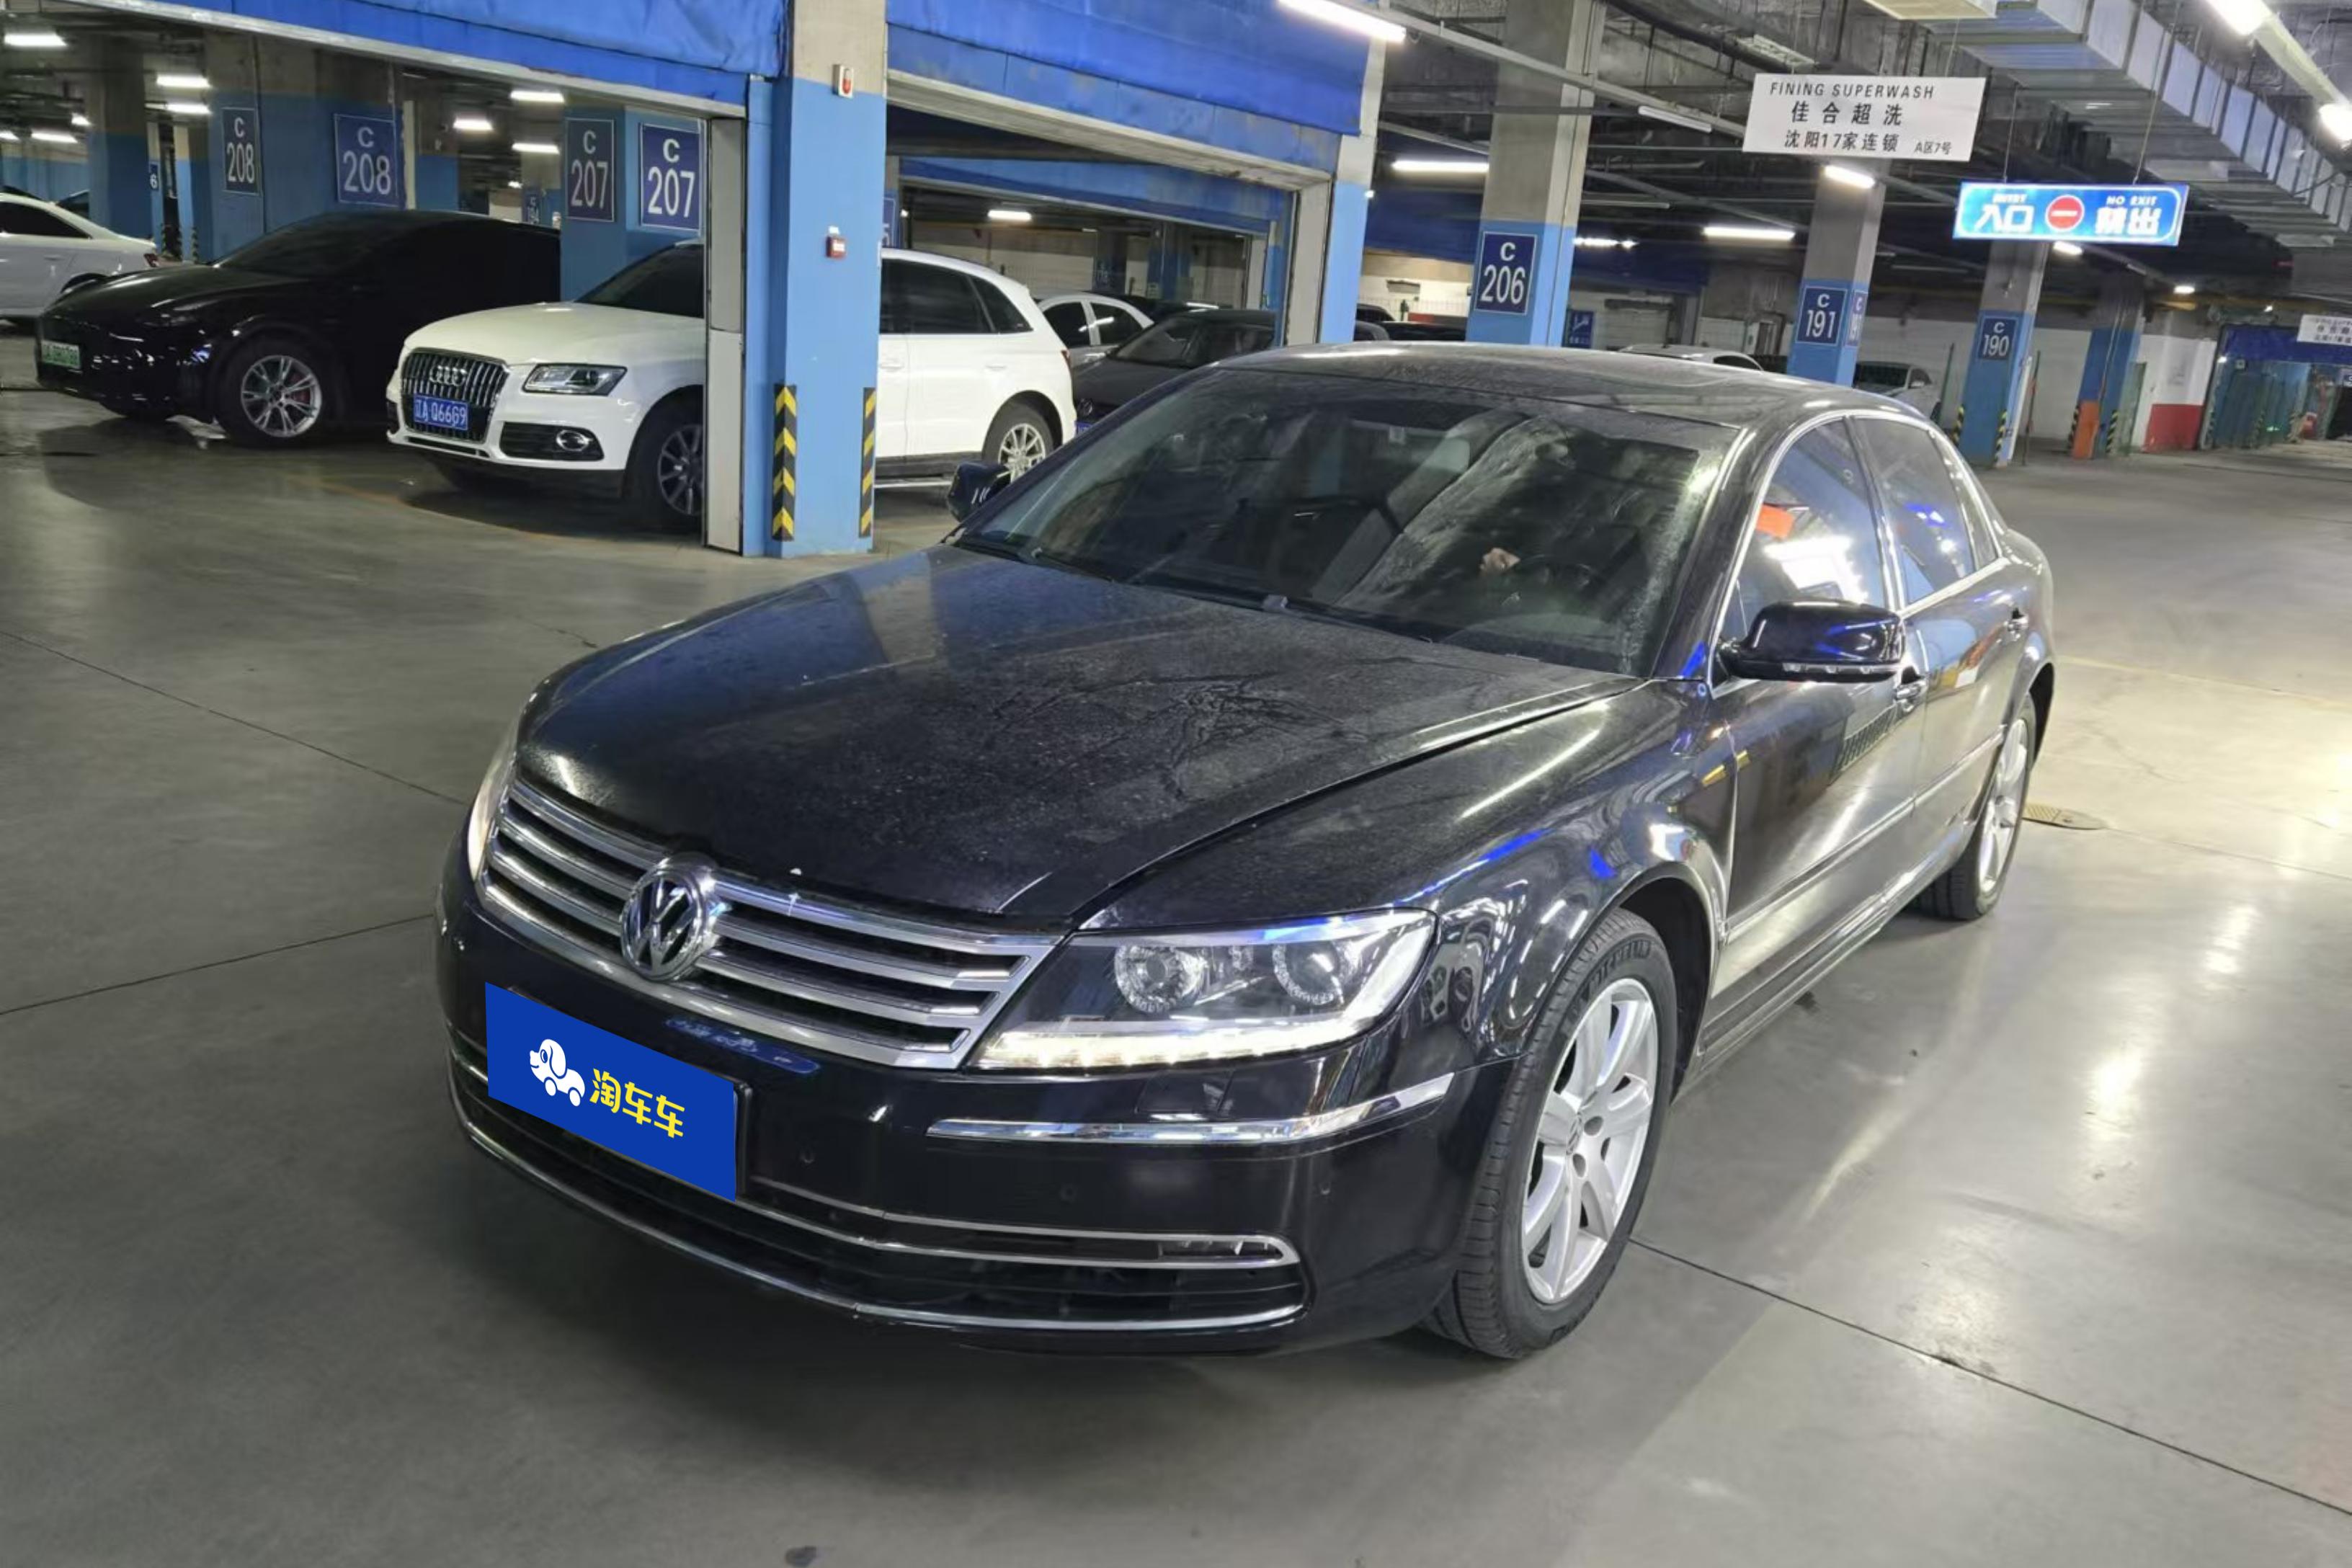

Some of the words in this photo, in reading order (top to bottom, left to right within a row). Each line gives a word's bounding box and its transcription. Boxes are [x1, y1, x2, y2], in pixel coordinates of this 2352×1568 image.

[1770, 82, 1825, 96] FINING
[1832, 84, 1935, 99] SUPERWASH
[1791, 101, 1902, 126] 佳合超洗
[234, 117, 246, 138] C
[357, 127, 374, 148] C
[583, 130, 597, 154] C
[662, 138, 680, 163] C
[1784, 130, 1900, 152] 沈阳17家连锁
[1914, 140, 1952, 155] A区7号
[226, 142, 255, 184] 208
[343, 150, 391, 195] 208
[571, 159, 608, 209] 207
[648, 166, 695, 218] 207
[2106, 195, 2124, 205] NO
[2130, 196, 2157, 206] EXIT
[1974, 204, 2035, 233] 入口
[1500, 242, 1516, 261] C
[1480, 264, 1526, 304] 206
[1817, 293, 1830, 308] C
[1805, 309, 1836, 338] 191
[1993, 321, 2005, 334] C
[1982, 334, 2009, 357] 190
